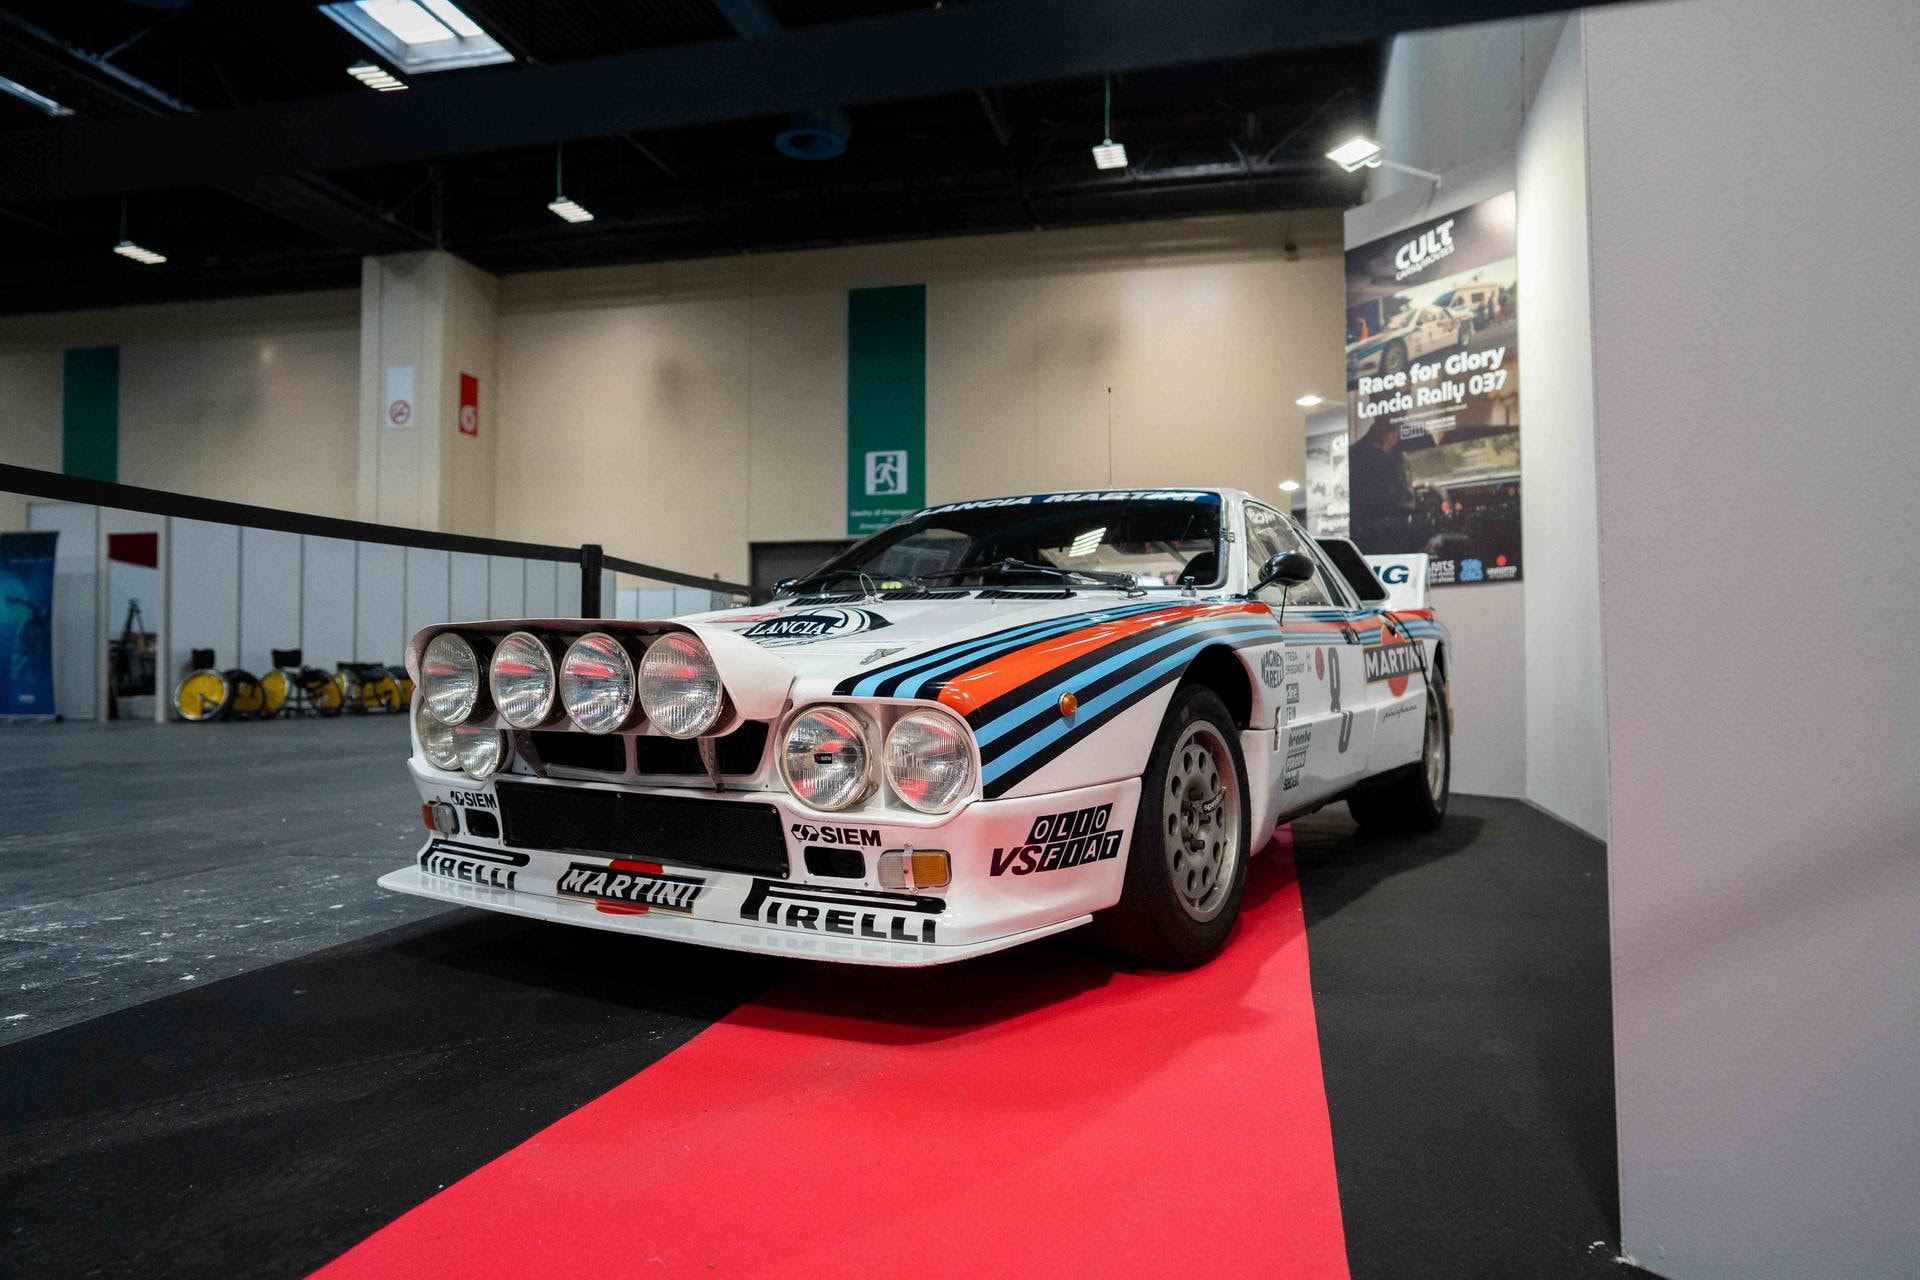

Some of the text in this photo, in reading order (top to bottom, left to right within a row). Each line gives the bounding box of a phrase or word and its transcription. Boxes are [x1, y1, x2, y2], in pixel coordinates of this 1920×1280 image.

[1395, 218, 1454, 270] CULT
[1358, 346, 1506, 396] Race for Glory
[1357, 392, 1414, 419] Lancia
[1416, 380, 1465, 407] Rally
[1469, 369, 1508, 395] 037
[914, 497, 1032, 518] LANCIA
[1043, 492, 1208, 503] MARTINI
[749, 620, 824, 635] LANCIA
[1365, 643, 1427, 679] MARTINI
[464, 792, 497, 809] SIEM
[822, 826, 882, 847] SIEM
[1031, 807, 1109, 842] OLIO
[420, 838, 531, 891] PIRELLI
[989, 833, 1121, 877] VS FIAT
[561, 868, 697, 908] MARTINI
[740, 877, 947, 944] PIRELLI
